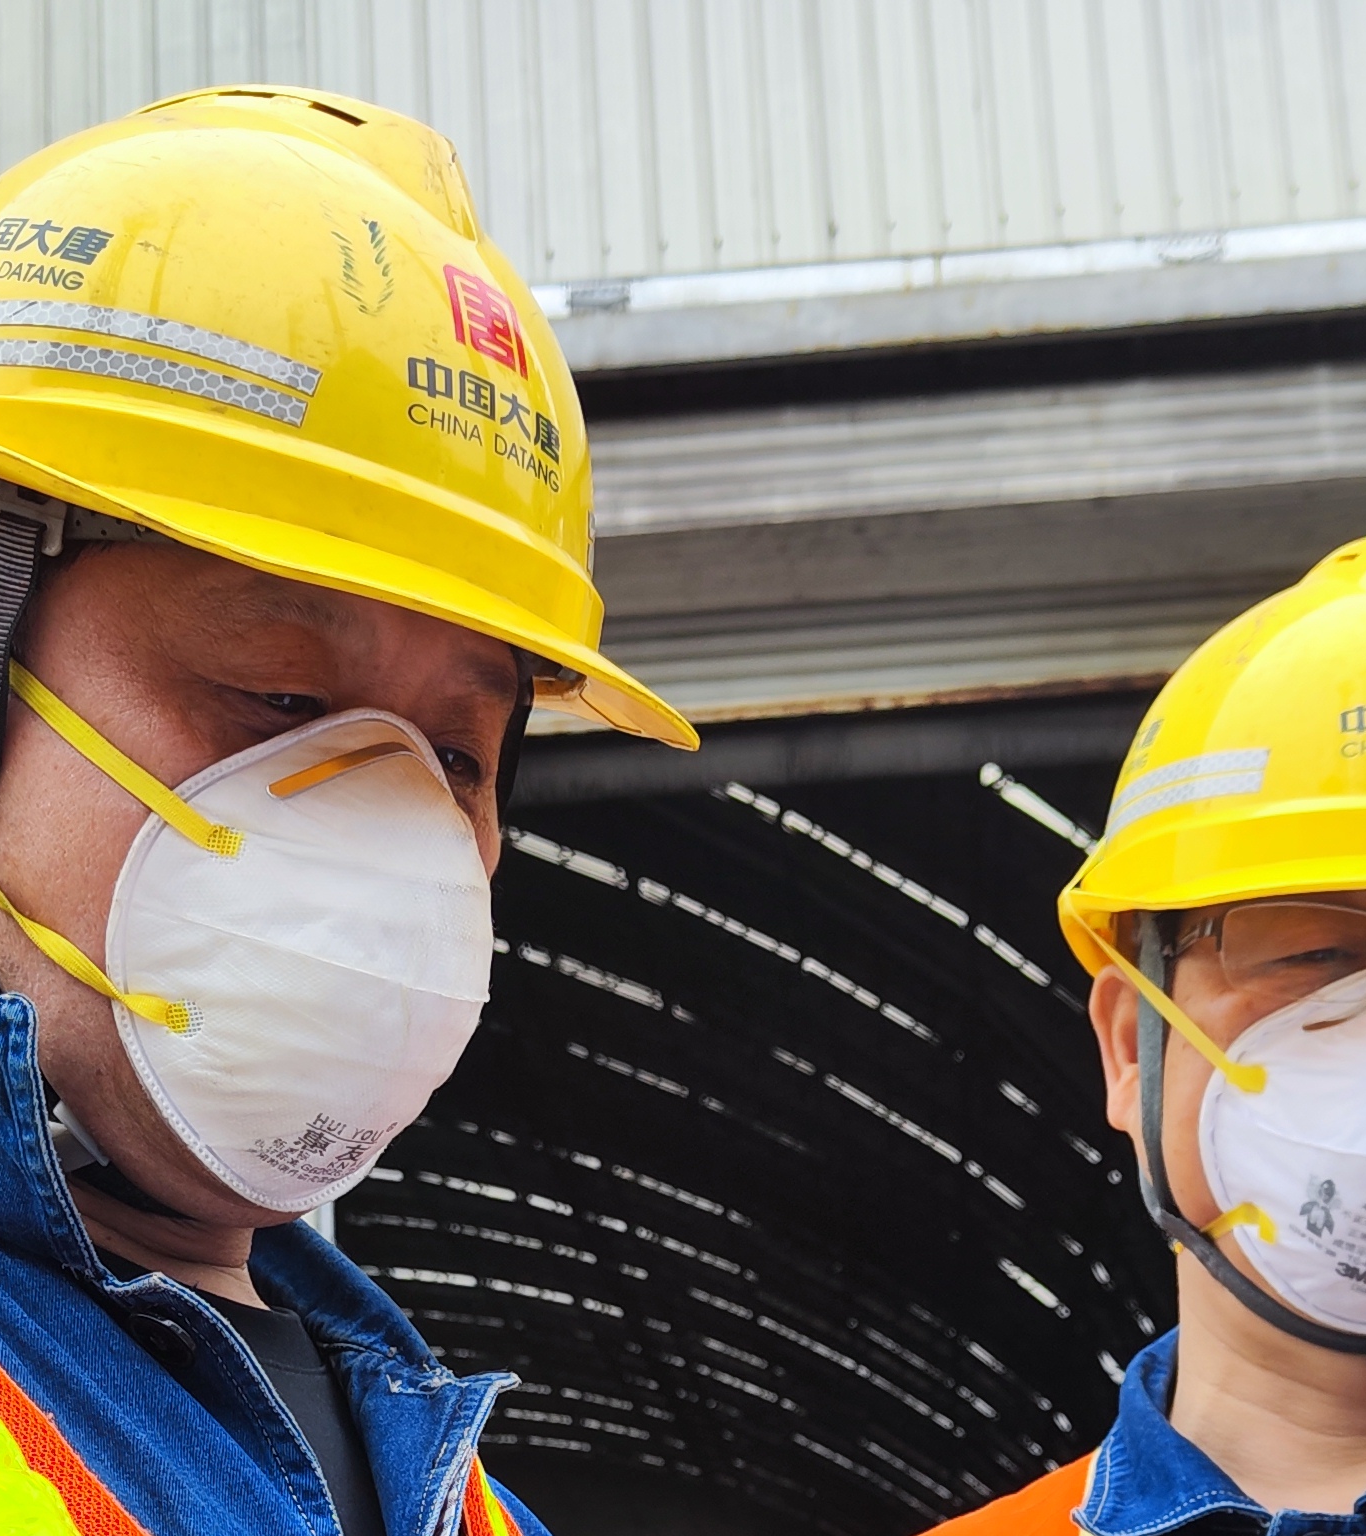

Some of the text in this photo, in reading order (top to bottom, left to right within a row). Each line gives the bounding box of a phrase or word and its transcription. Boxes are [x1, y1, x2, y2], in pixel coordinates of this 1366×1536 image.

[407, 356, 560, 465] 中国大唐
[407, 403, 560, 493] CHINA DATANG
[294, 1129, 372, 1161] 惠友
[313, 1112, 384, 1143] HUI YOU
